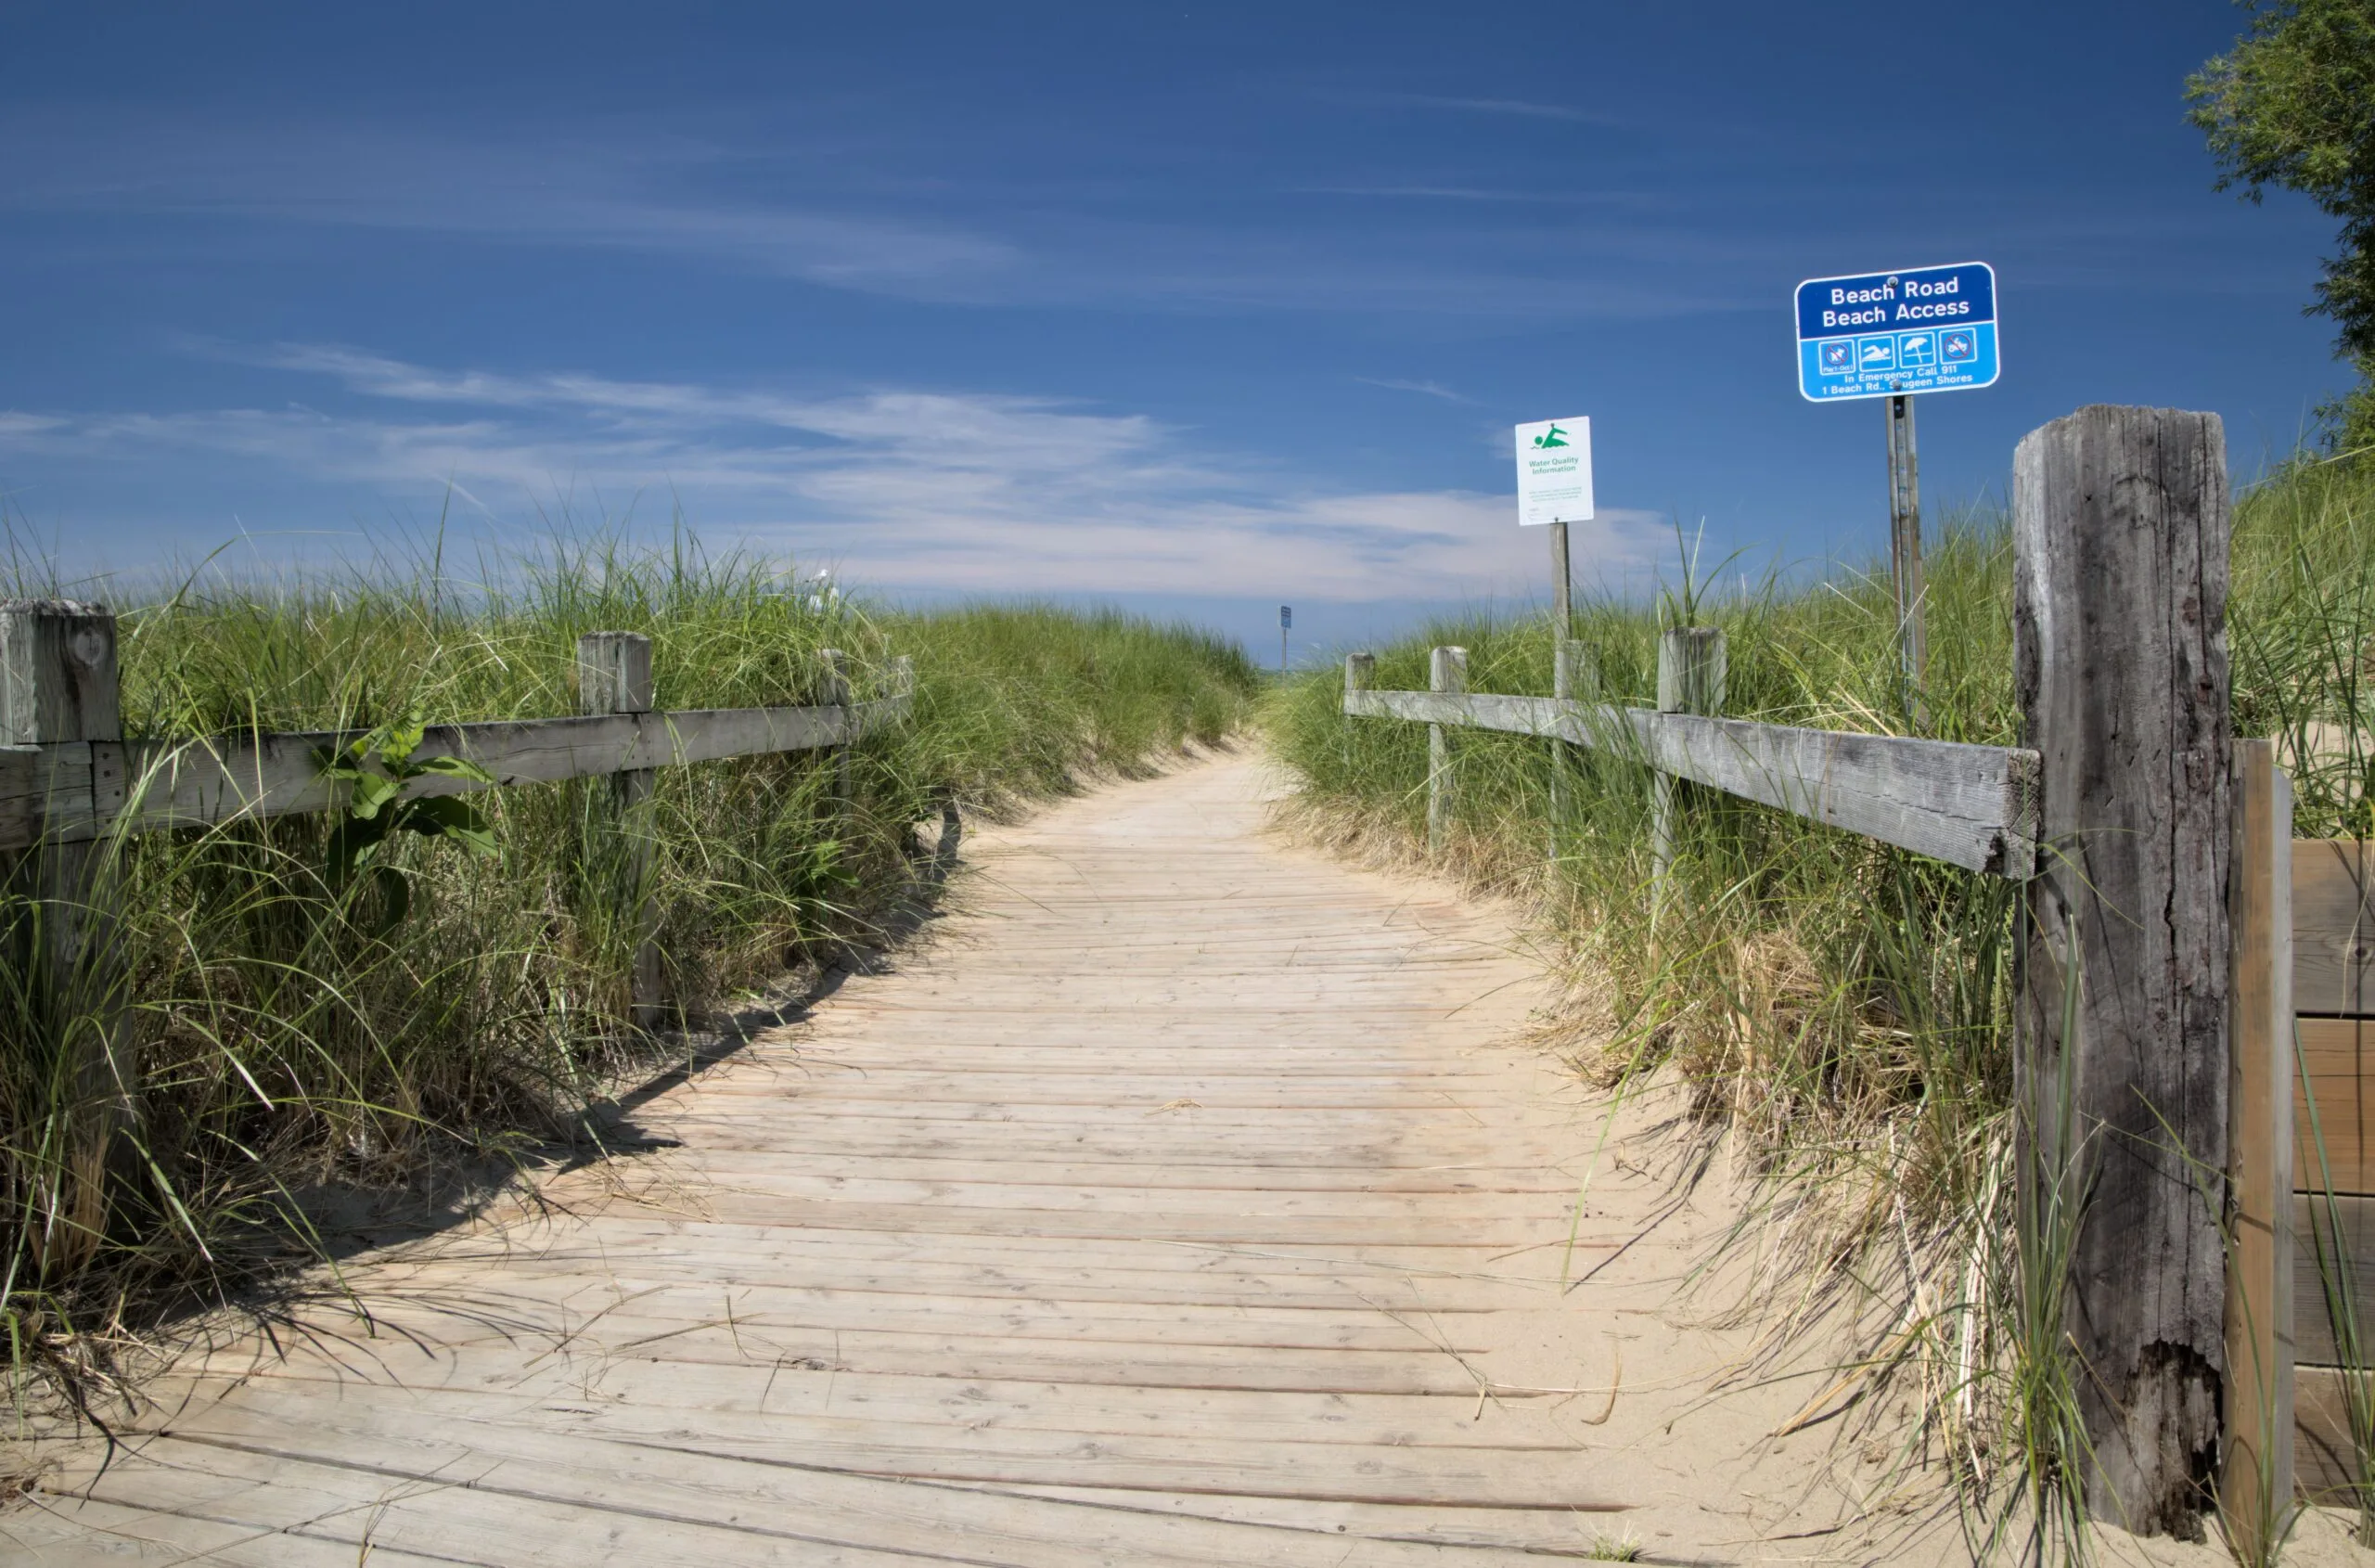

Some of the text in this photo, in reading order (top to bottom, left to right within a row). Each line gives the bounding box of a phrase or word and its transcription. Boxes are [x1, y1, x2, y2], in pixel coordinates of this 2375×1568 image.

[1831, 276, 1958, 305] Beach Road
[1823, 301, 1970, 328] Beach Access
[1844, 365, 1958, 383] In Emergency Call 911
[1831, 384, 1862, 394] Beach
[1889, 379, 1932, 390] Sugeen
[1937, 374, 1973, 385] Shores
[1532, 465, 1576, 475] Information
[1552, 456, 1578, 466] Quality
